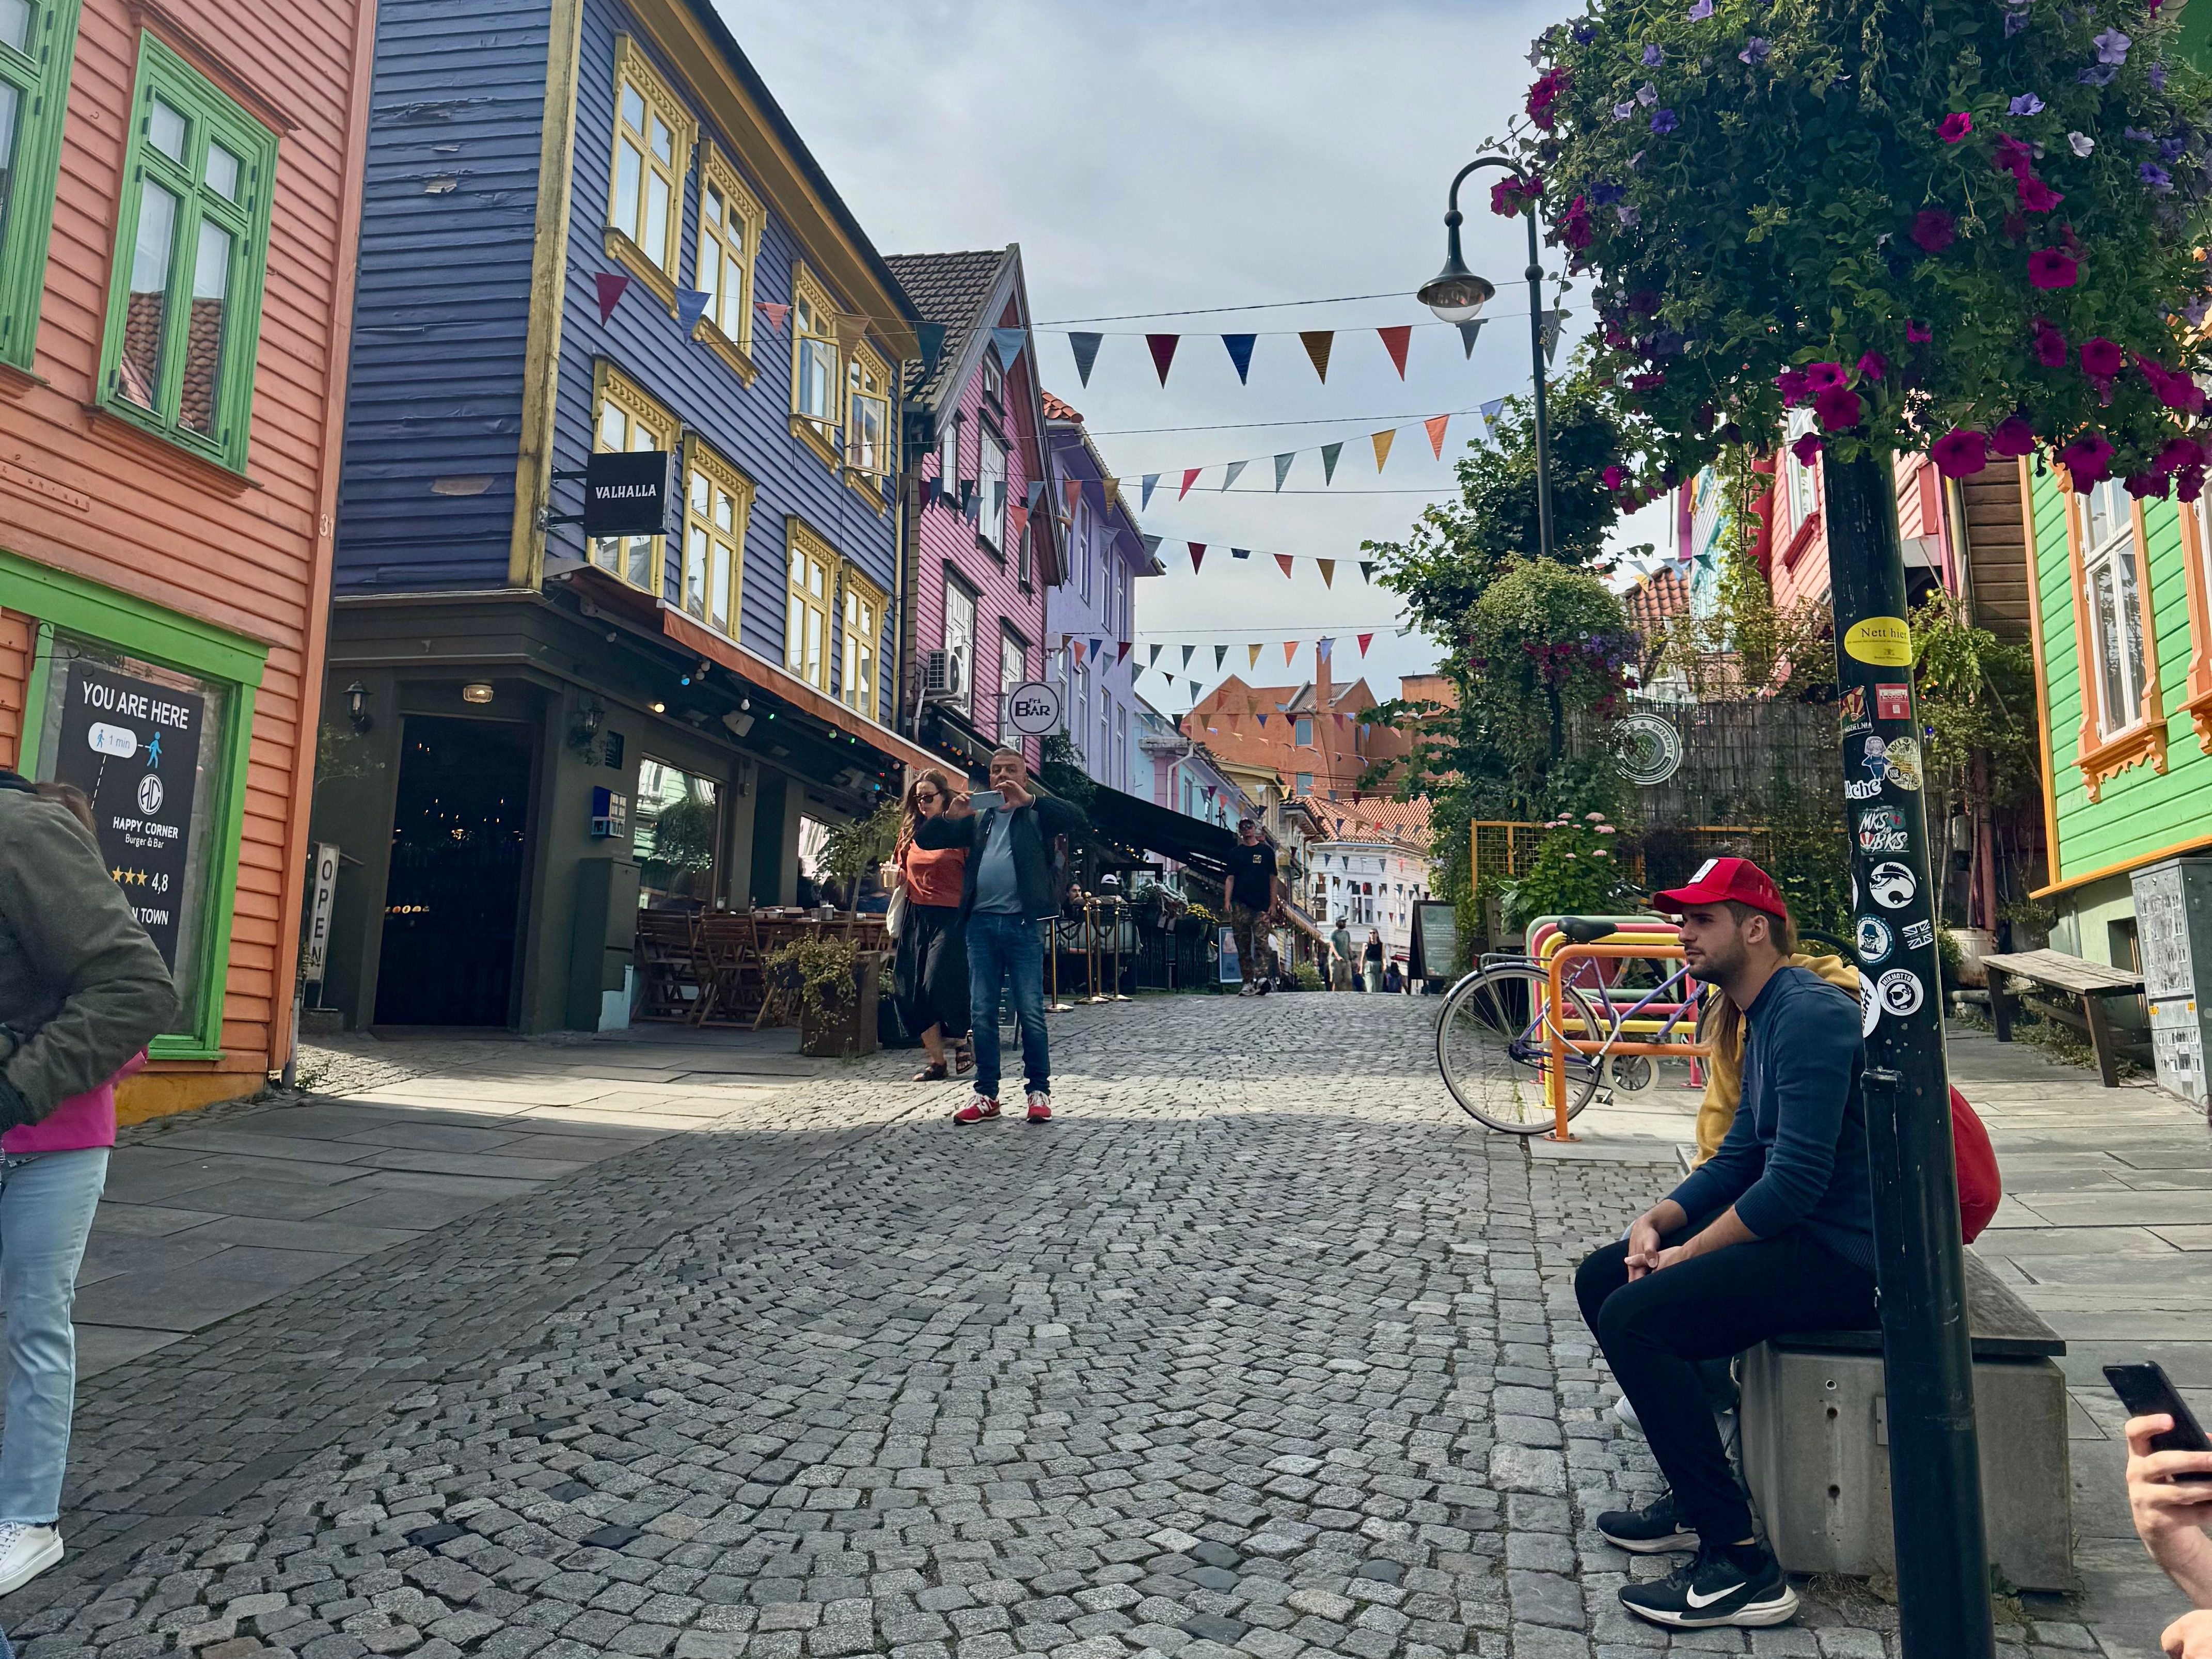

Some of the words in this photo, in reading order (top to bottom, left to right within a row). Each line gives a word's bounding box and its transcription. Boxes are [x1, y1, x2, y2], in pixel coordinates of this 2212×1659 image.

[595, 484, 656, 499] VALHALLA
[320, 513, 335, 540] 31
[1860, 628, 1886, 638] Nett
[83, 681, 115, 710] YOU
[116, 692, 148, 719] ARE
[151, 700, 189, 730] HERE
[1015, 701, 1050, 717] BAR
[109, 735, 113, 745] 1
[116, 737, 130, 749] min
[113, 816, 143, 832] HAPPY
[145, 822, 179, 839] CORNER
[1859, 812, 1889, 833] MKS
[125, 833, 146, 847] Burger
[147, 837, 152, 847] &
[153, 838, 164, 848] Bar
[1870, 831, 1908, 853] BKS
[151, 873, 168, 894] 4,8
[132, 907, 138, 920] N
[141, 908, 168, 925] TOWN
[311, 859, 333, 967] OPEN
[1882, 973, 1912, 986] MIKMOTTO
